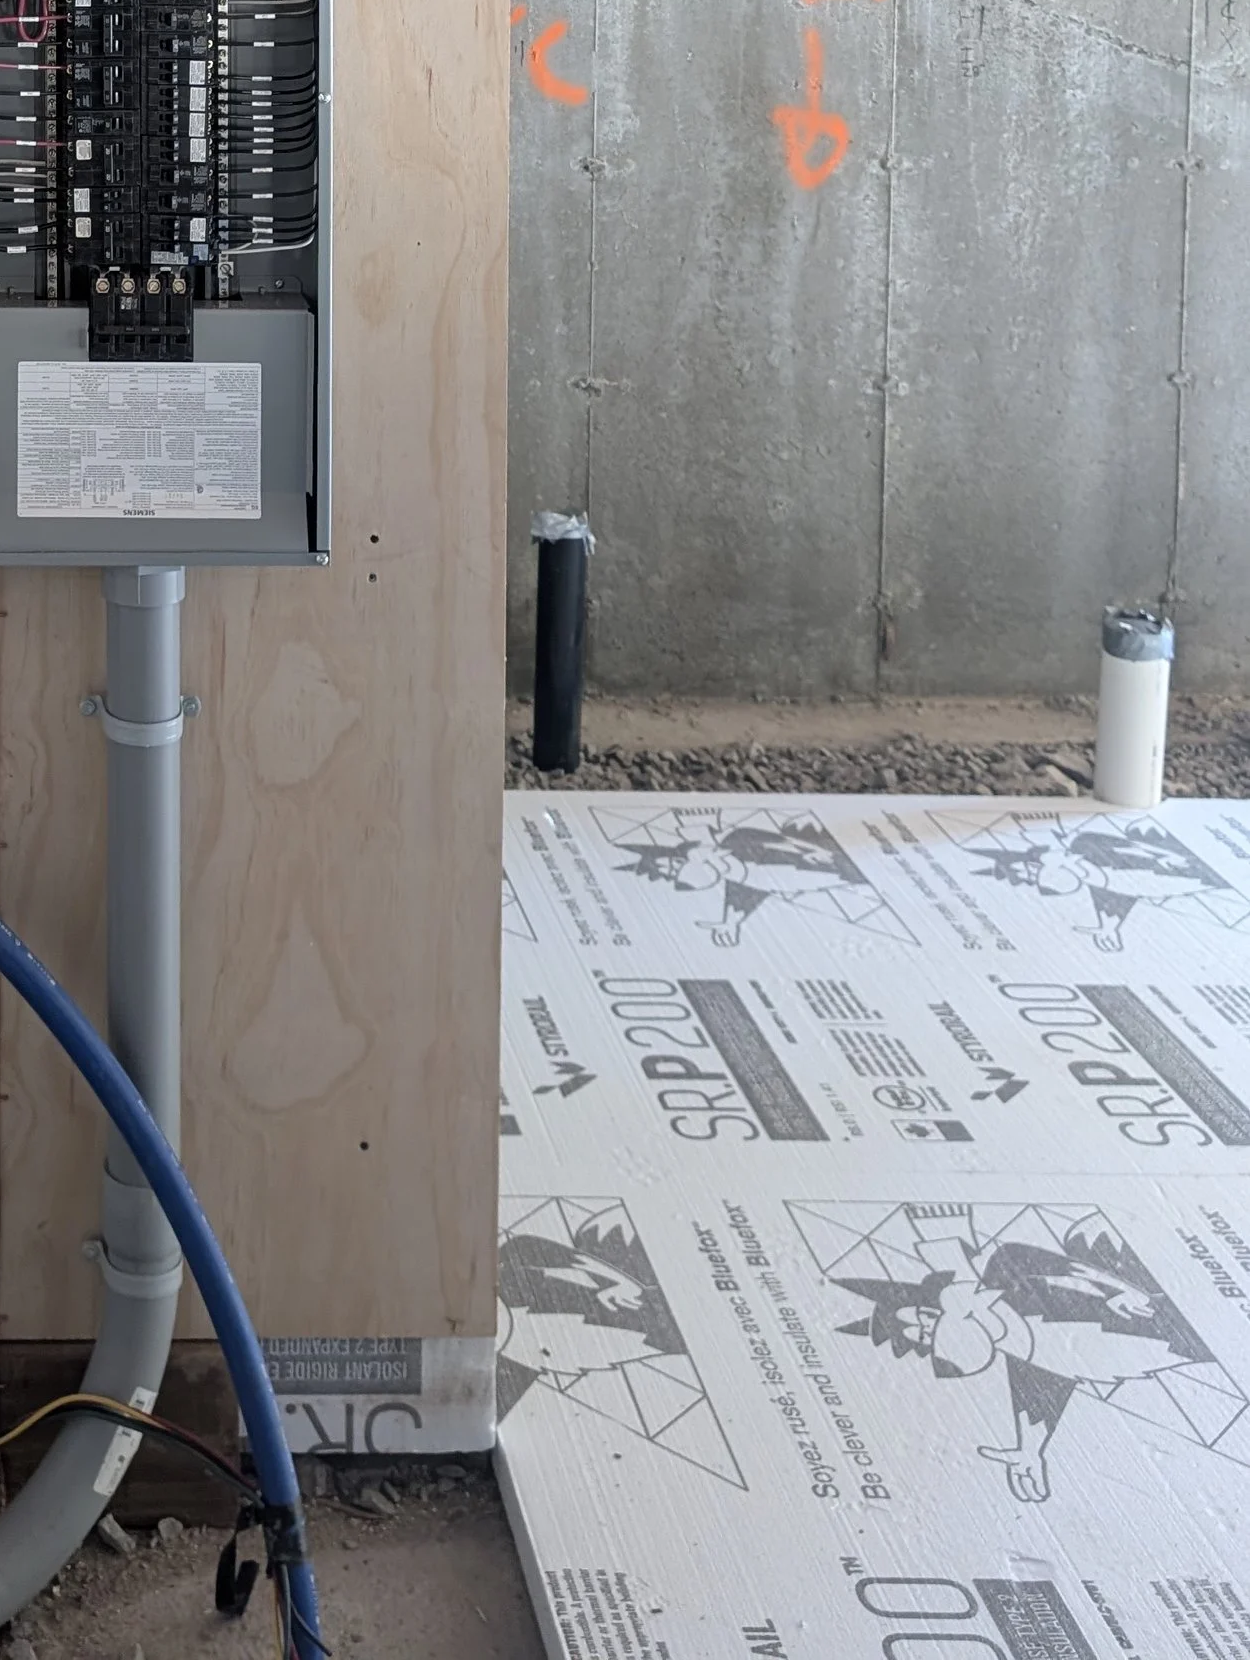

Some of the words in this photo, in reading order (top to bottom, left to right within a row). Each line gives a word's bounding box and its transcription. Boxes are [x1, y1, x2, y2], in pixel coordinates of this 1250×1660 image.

[926, 1000, 995, 1064] STYRORAIL
[760, 1269, 789, 1303] with
[729, 1295, 761, 1335] avec
[268, 1338, 350, 1356] EXPANDED
[354, 1338, 365, 1356] 2
[372, 1338, 408, 1356] TYPE
[778, 1305, 823, 1371] insulate
[285, 1360, 338, 1382] RIGIDE
[345, 1360, 408, 1381] ISOLANT
[750, 1337, 786, 1387] isolez
[805, 1372, 842, 1407] and
[769, 1391, 810, 1436] rusé,
[835, 1409, 874, 1468] clever
[799, 1441, 841, 1499] Soyez
[860, 1470, 892, 1501] Be
[545, 1571, 565, 1599] product
[579, 1568, 595, 1593] barrier
[585, 1594, 606, 1623] thermal
[1002, 1608, 1035, 1639] TYPE
